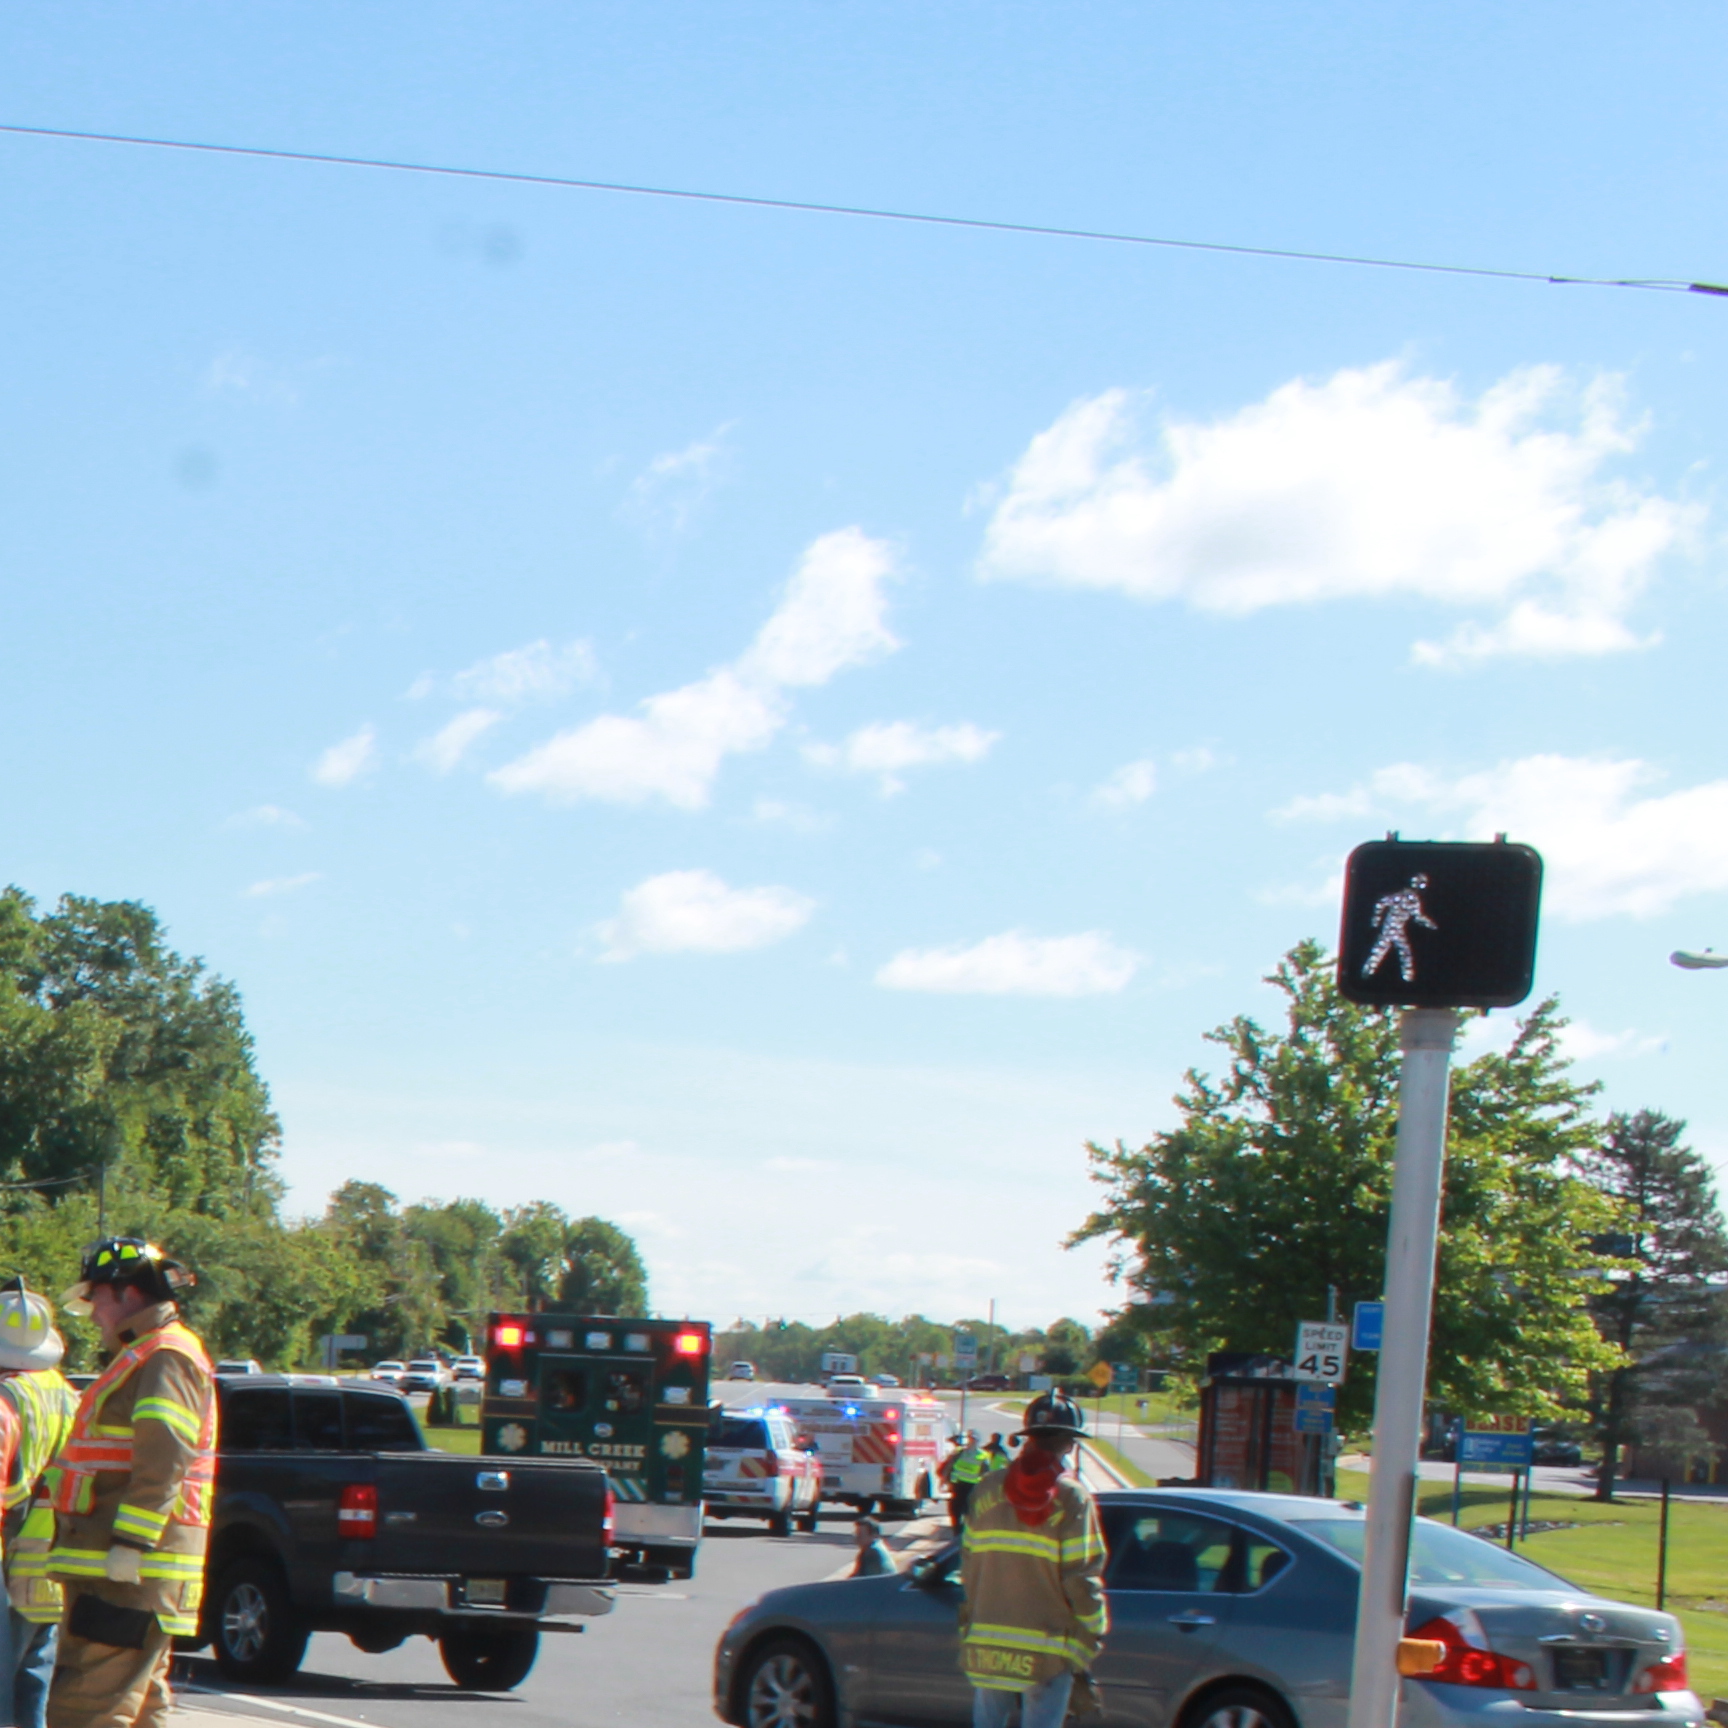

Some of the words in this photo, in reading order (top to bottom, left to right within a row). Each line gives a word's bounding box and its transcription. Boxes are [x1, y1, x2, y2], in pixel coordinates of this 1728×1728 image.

[1302, 1327, 1344, 1341] SPEED
[1304, 1341, 1337, 1351] LIMIT
[1298, 1354, 1340, 1377] 45
[540, 1440, 583, 1454] MILL
[587, 1443, 646, 1458] CREEK
